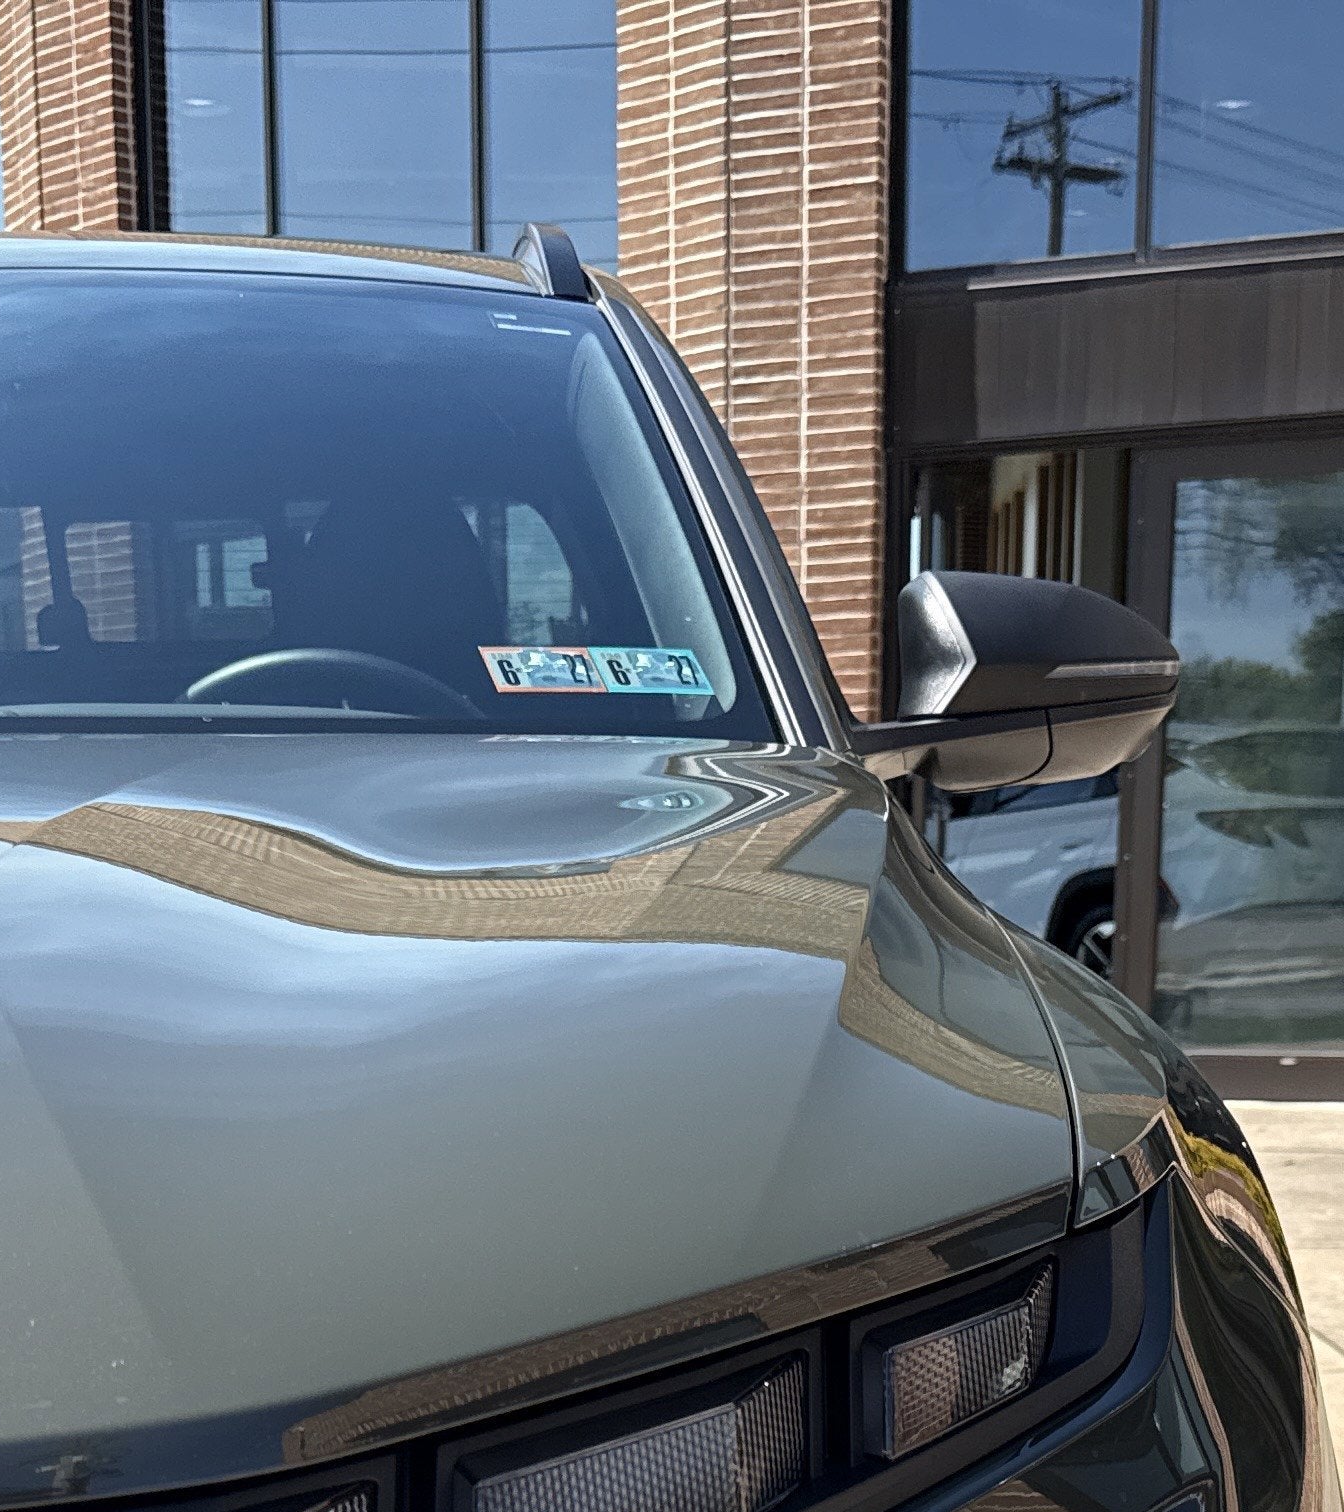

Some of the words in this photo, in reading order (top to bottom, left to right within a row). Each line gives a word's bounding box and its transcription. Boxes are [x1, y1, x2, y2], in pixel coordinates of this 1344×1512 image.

[497, 659, 522, 686] 6
[562, 653, 594, 686] 27
[606, 659, 631, 686] 6
[667, 655, 699, 687] 27
